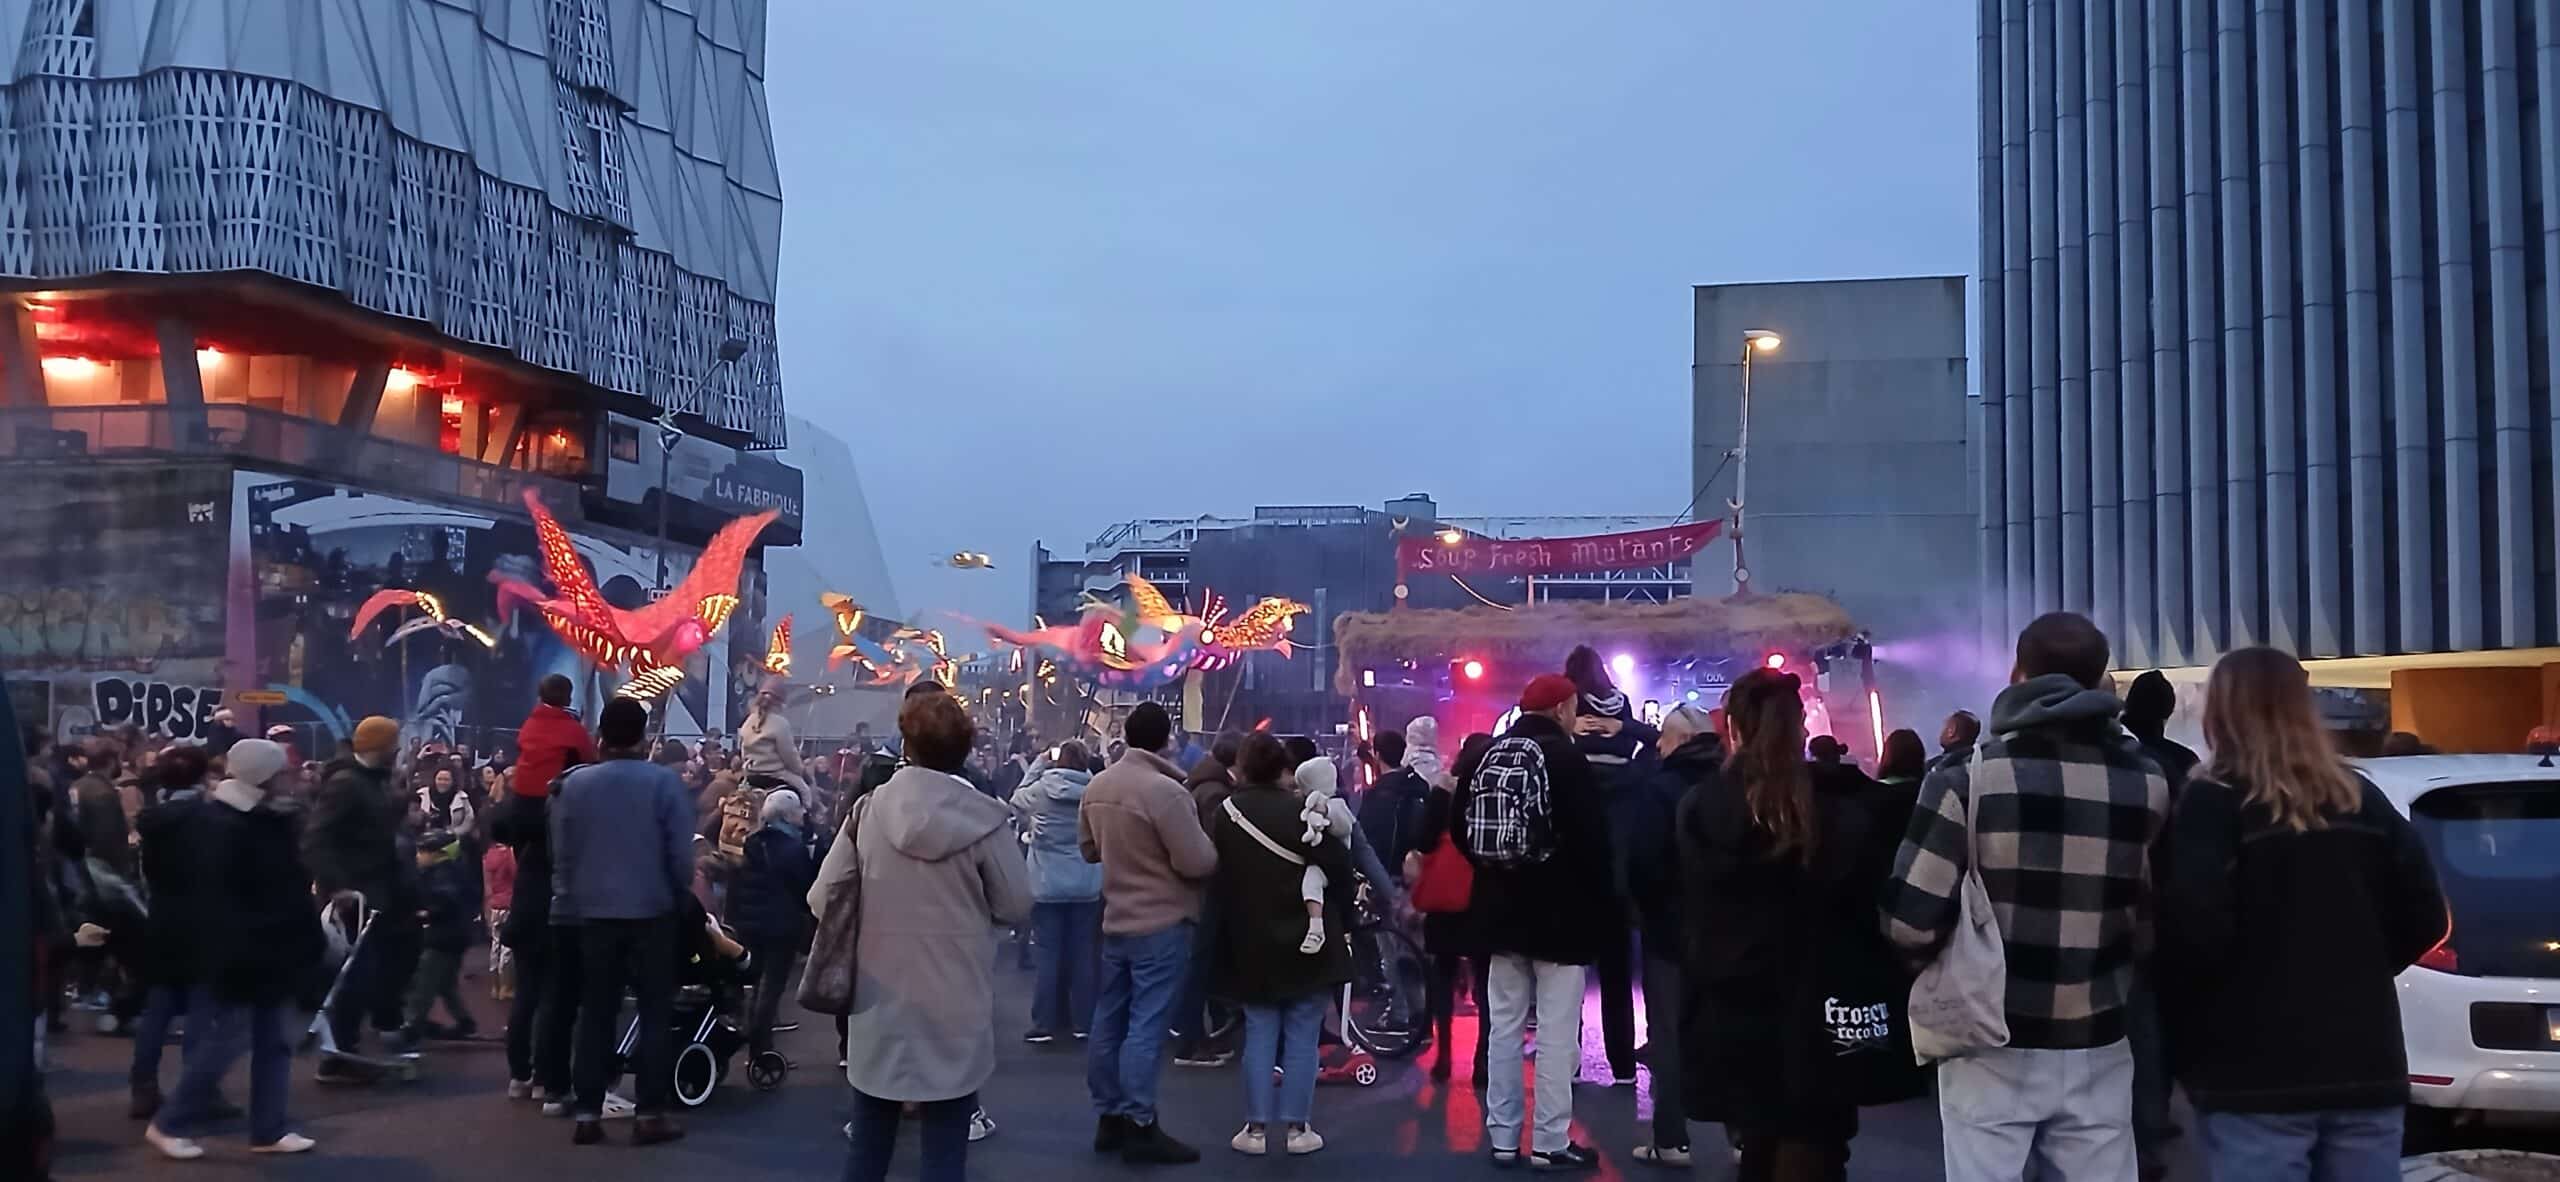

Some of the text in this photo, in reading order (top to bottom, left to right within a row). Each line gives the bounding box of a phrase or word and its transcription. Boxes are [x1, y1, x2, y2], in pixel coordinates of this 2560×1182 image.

[716, 477, 800, 516] LA FABRIQUE
[1837, 1022, 1889, 1040] recods
